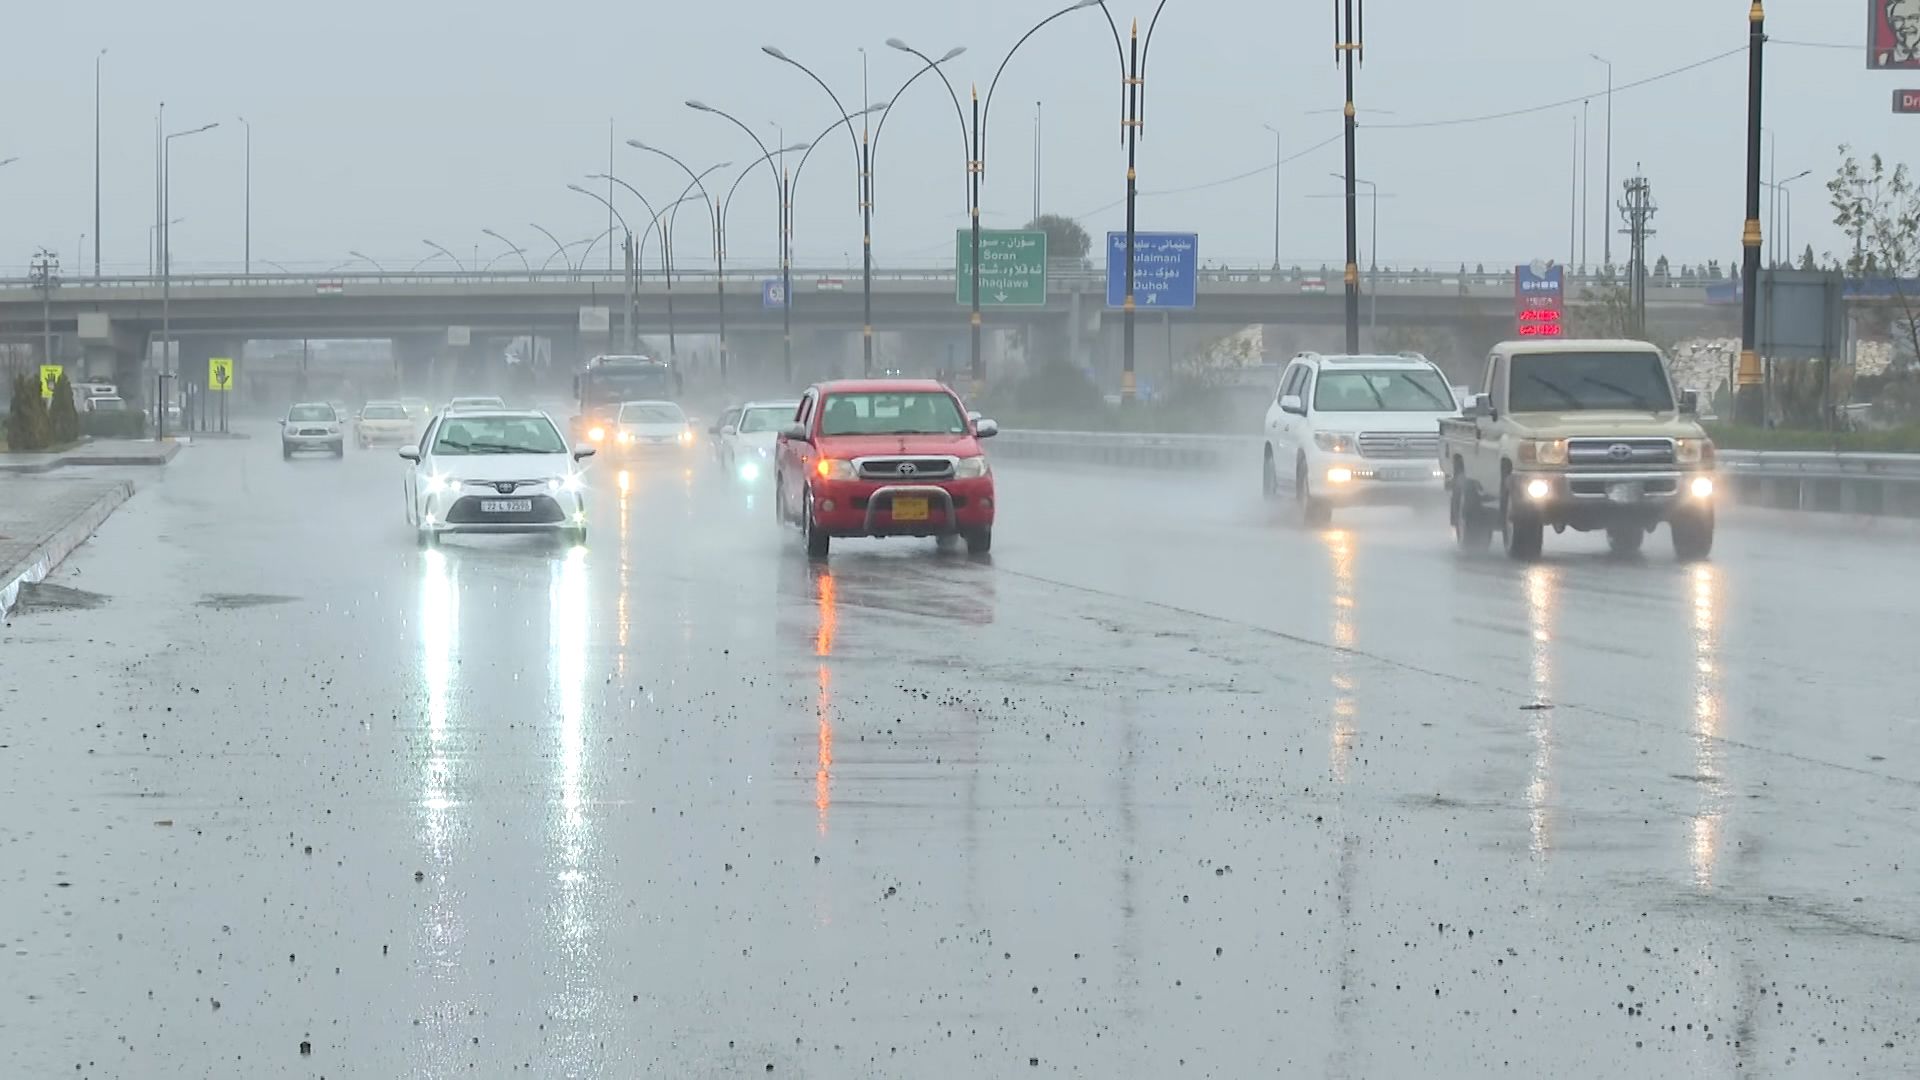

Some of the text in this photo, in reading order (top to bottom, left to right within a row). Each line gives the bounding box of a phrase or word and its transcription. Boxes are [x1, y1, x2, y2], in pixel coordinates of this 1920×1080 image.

[984, 248, 1017, 260] Soran
[1133, 253, 1181, 264] ulaimani
[978, 277, 1029, 289] haqlawa
[1133, 281, 1169, 290] Duhok
